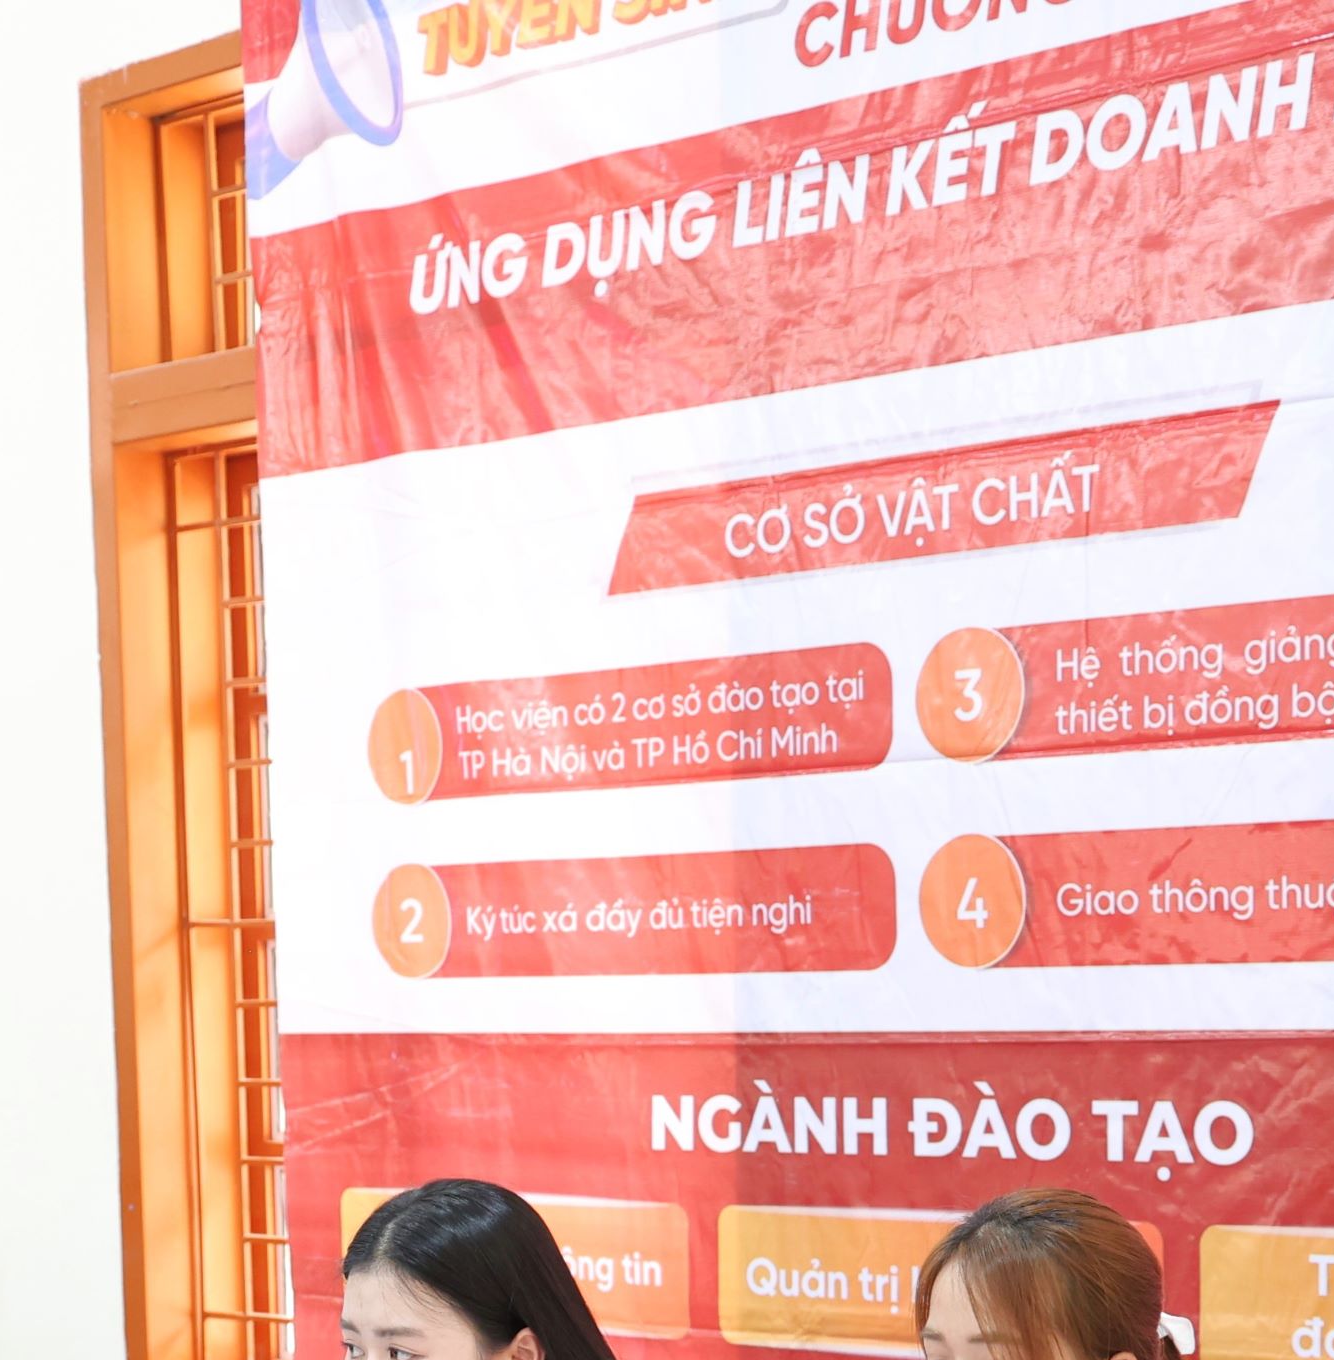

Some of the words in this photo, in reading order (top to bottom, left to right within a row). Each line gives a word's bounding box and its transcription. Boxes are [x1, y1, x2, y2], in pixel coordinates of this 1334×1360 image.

[409, 233, 527, 315] ỨNG
[542, 190, 717, 297] DỤNG
[733, 148, 870, 248] LIÊN
[885, 100, 1015, 215] KẾT
[1029, 53, 1315, 186] DOANH
[724, 505, 792, 559] CƠ
[803, 483, 865, 548] SỞ
[876, 477, 959, 547] VẬT
[971, 450, 1099, 526] CHẤT
[1055, 647, 1101, 689] Hệ
[1119, 634, 1224, 679] thống
[455, 704, 504, 740] Học
[511, 703, 568, 737] viện
[573, 694, 605, 728] có
[611, 691, 627, 725] 2
[632, 692, 669, 722] cơ
[671, 683, 702, 718] sở
[708, 681, 764, 714] đào
[769, 679, 820, 717] tạo
[826, 671, 864, 715] tại
[953, 668, 982, 723] 3
[1055, 693, 1133, 737] thiết
[1143, 696, 1175, 737] bị
[1184, 684, 1280, 730] đồng
[399, 750, 415, 794] 1
[458, 750, 485, 779] TP
[491, 743, 531, 778] Hà
[540, 744, 587, 782] Nội
[594, 742, 625, 771] và
[632, 737, 665, 768] TP
[672, 726, 709, 766] Hồ
[716, 728, 763, 760] Chí
[770, 723, 839, 757] Minh
[400, 898, 424, 943] 2
[467, 902, 497, 940] Ký
[500, 904, 536, 933] túc
[542, 901, 578, 932] xá
[585, 897, 641, 939] đầy
[649, 897, 686, 930] đủ
[689, 897, 744, 936] tiện
[751, 894, 813, 935] nghi
[956, 878, 988, 929] 4
[1056, 882, 1139, 917] Giao
[1149, 878, 1255, 921] thông
[650, 1079, 888, 1157] NGÀNH
[908, 1081, 1071, 1161] ĐÀO
[1092, 1100, 1255, 1182] TẠO
[621, 1251, 662, 1287] tin
[746, 1257, 849, 1300] Quản
[858, 1264, 899, 1314] trị
